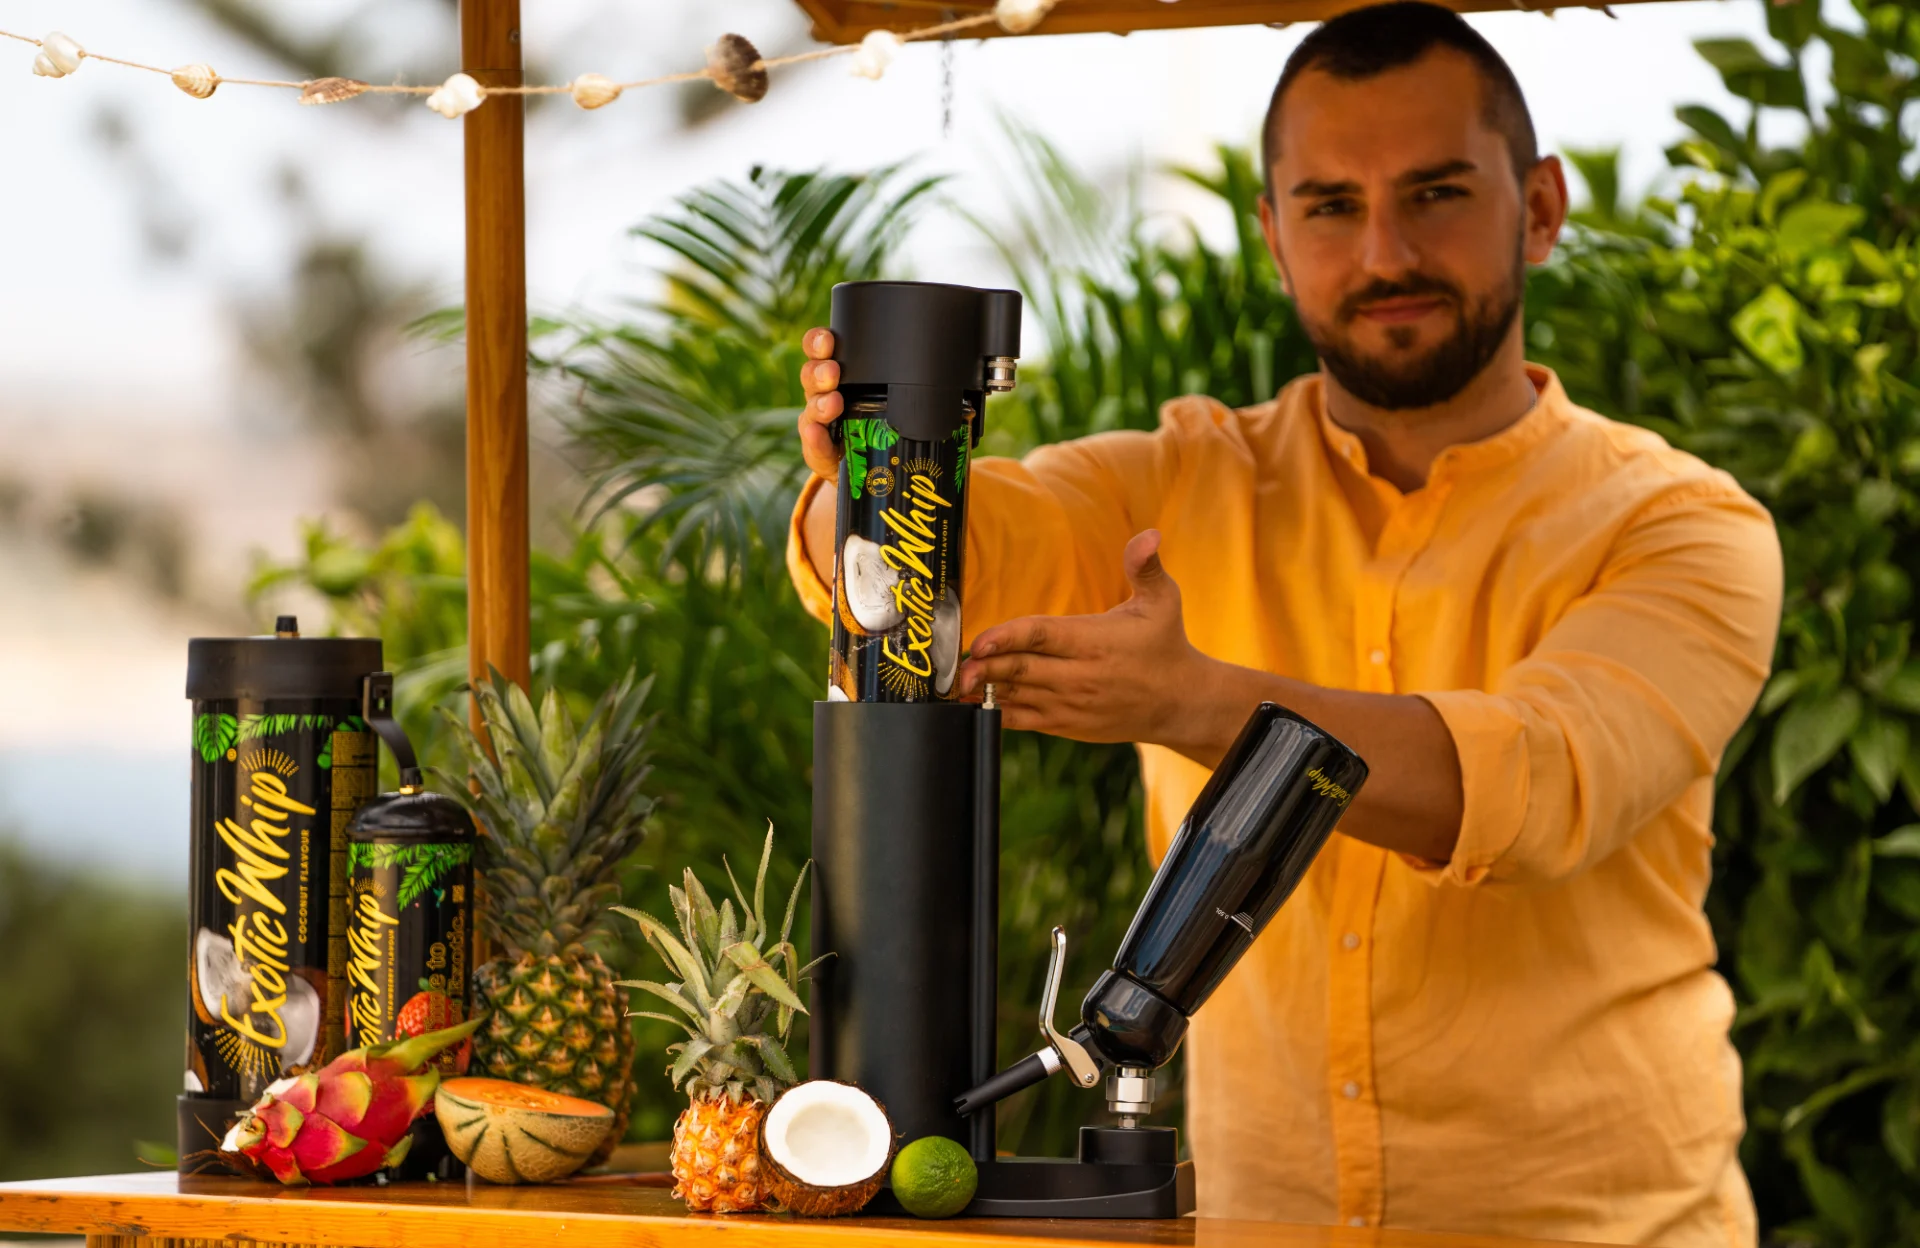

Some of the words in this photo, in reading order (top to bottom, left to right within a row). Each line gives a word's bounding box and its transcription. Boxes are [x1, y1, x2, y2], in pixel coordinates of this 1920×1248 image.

[879, 474, 952, 579] Whip
[882, 577, 935, 677] Exotic
[1308, 766, 1336, 796] Whip
[214, 772, 316, 915] Whip
[300, 829, 310, 882] FLAVOUR
[299, 885, 309, 944] COCONUT
[347, 894, 400, 995] Whip
[387, 929, 395, 966] FLAVOUR
[426, 942, 446, 973] to
[220, 911, 290, 1048] Exotic
[387, 967, 395, 1021] STRAWBERRY
[350, 991, 383, 1049] otic
